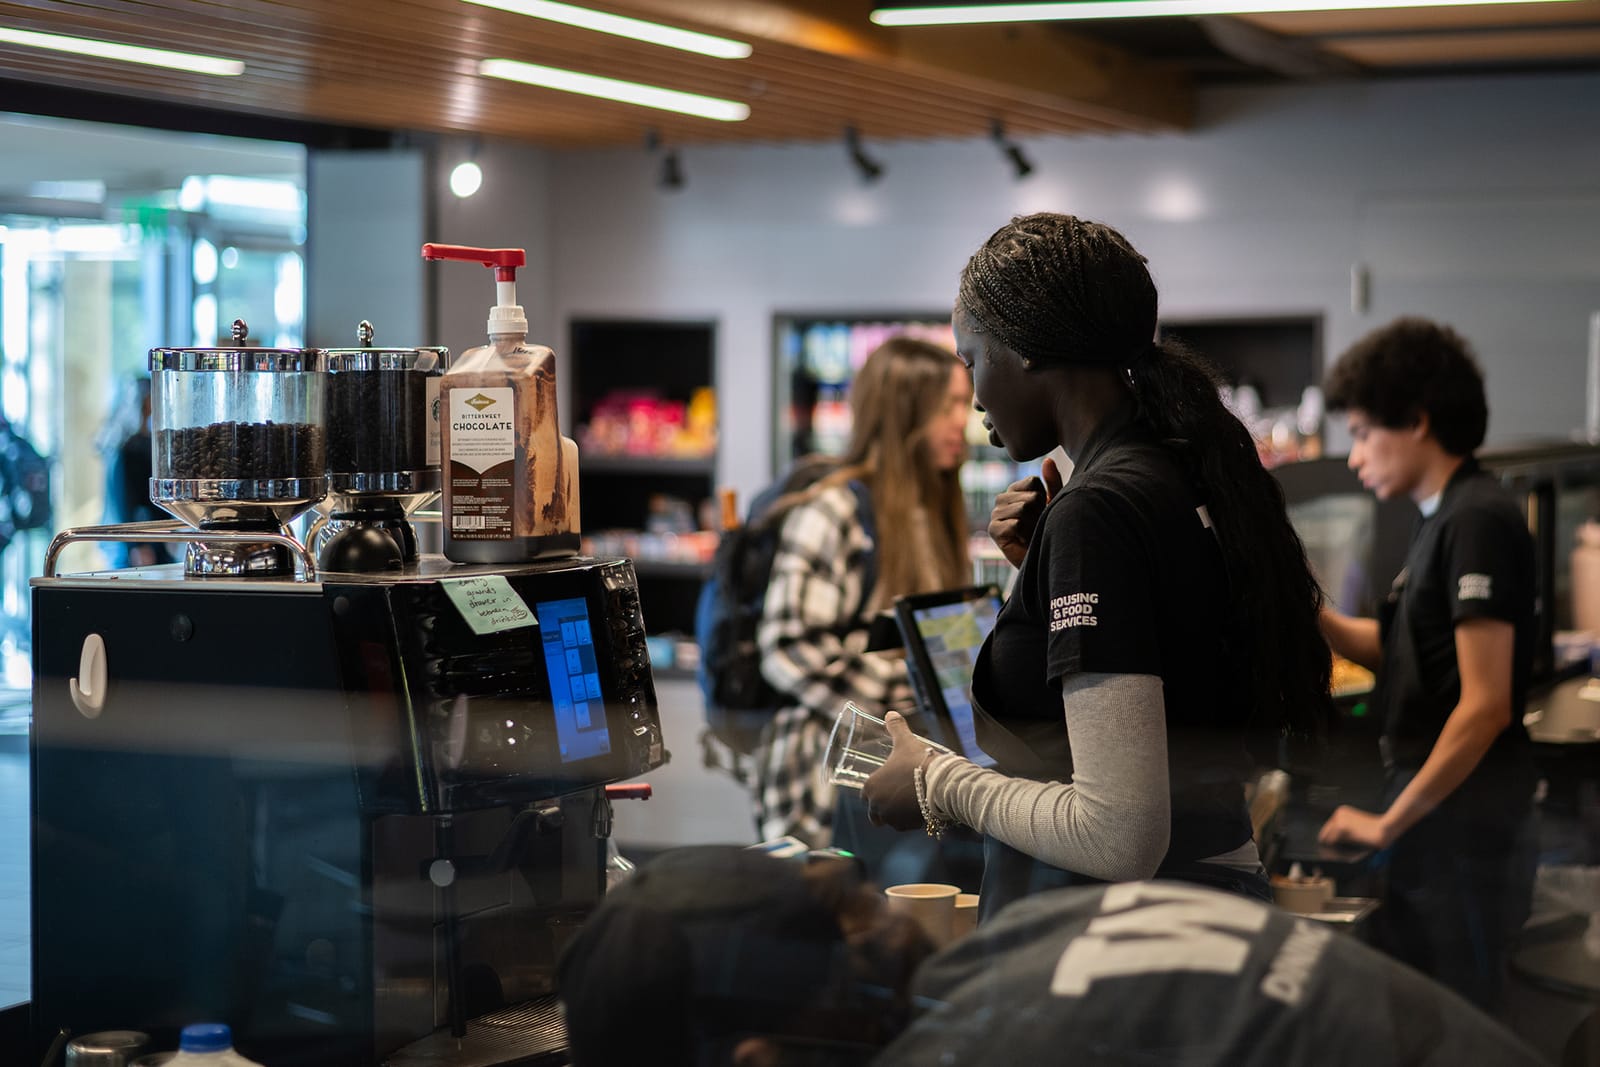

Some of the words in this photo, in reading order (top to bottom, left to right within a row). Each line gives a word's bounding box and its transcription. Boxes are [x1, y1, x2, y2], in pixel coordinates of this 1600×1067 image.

[453, 422, 512, 431] CHOCOLATE
[1050, 593, 1098, 609] HOUSING
[1053, 609, 1061, 620] &
[1062, 604, 1093, 618] FOOD
[1050, 616, 1098, 632] SERVICES
